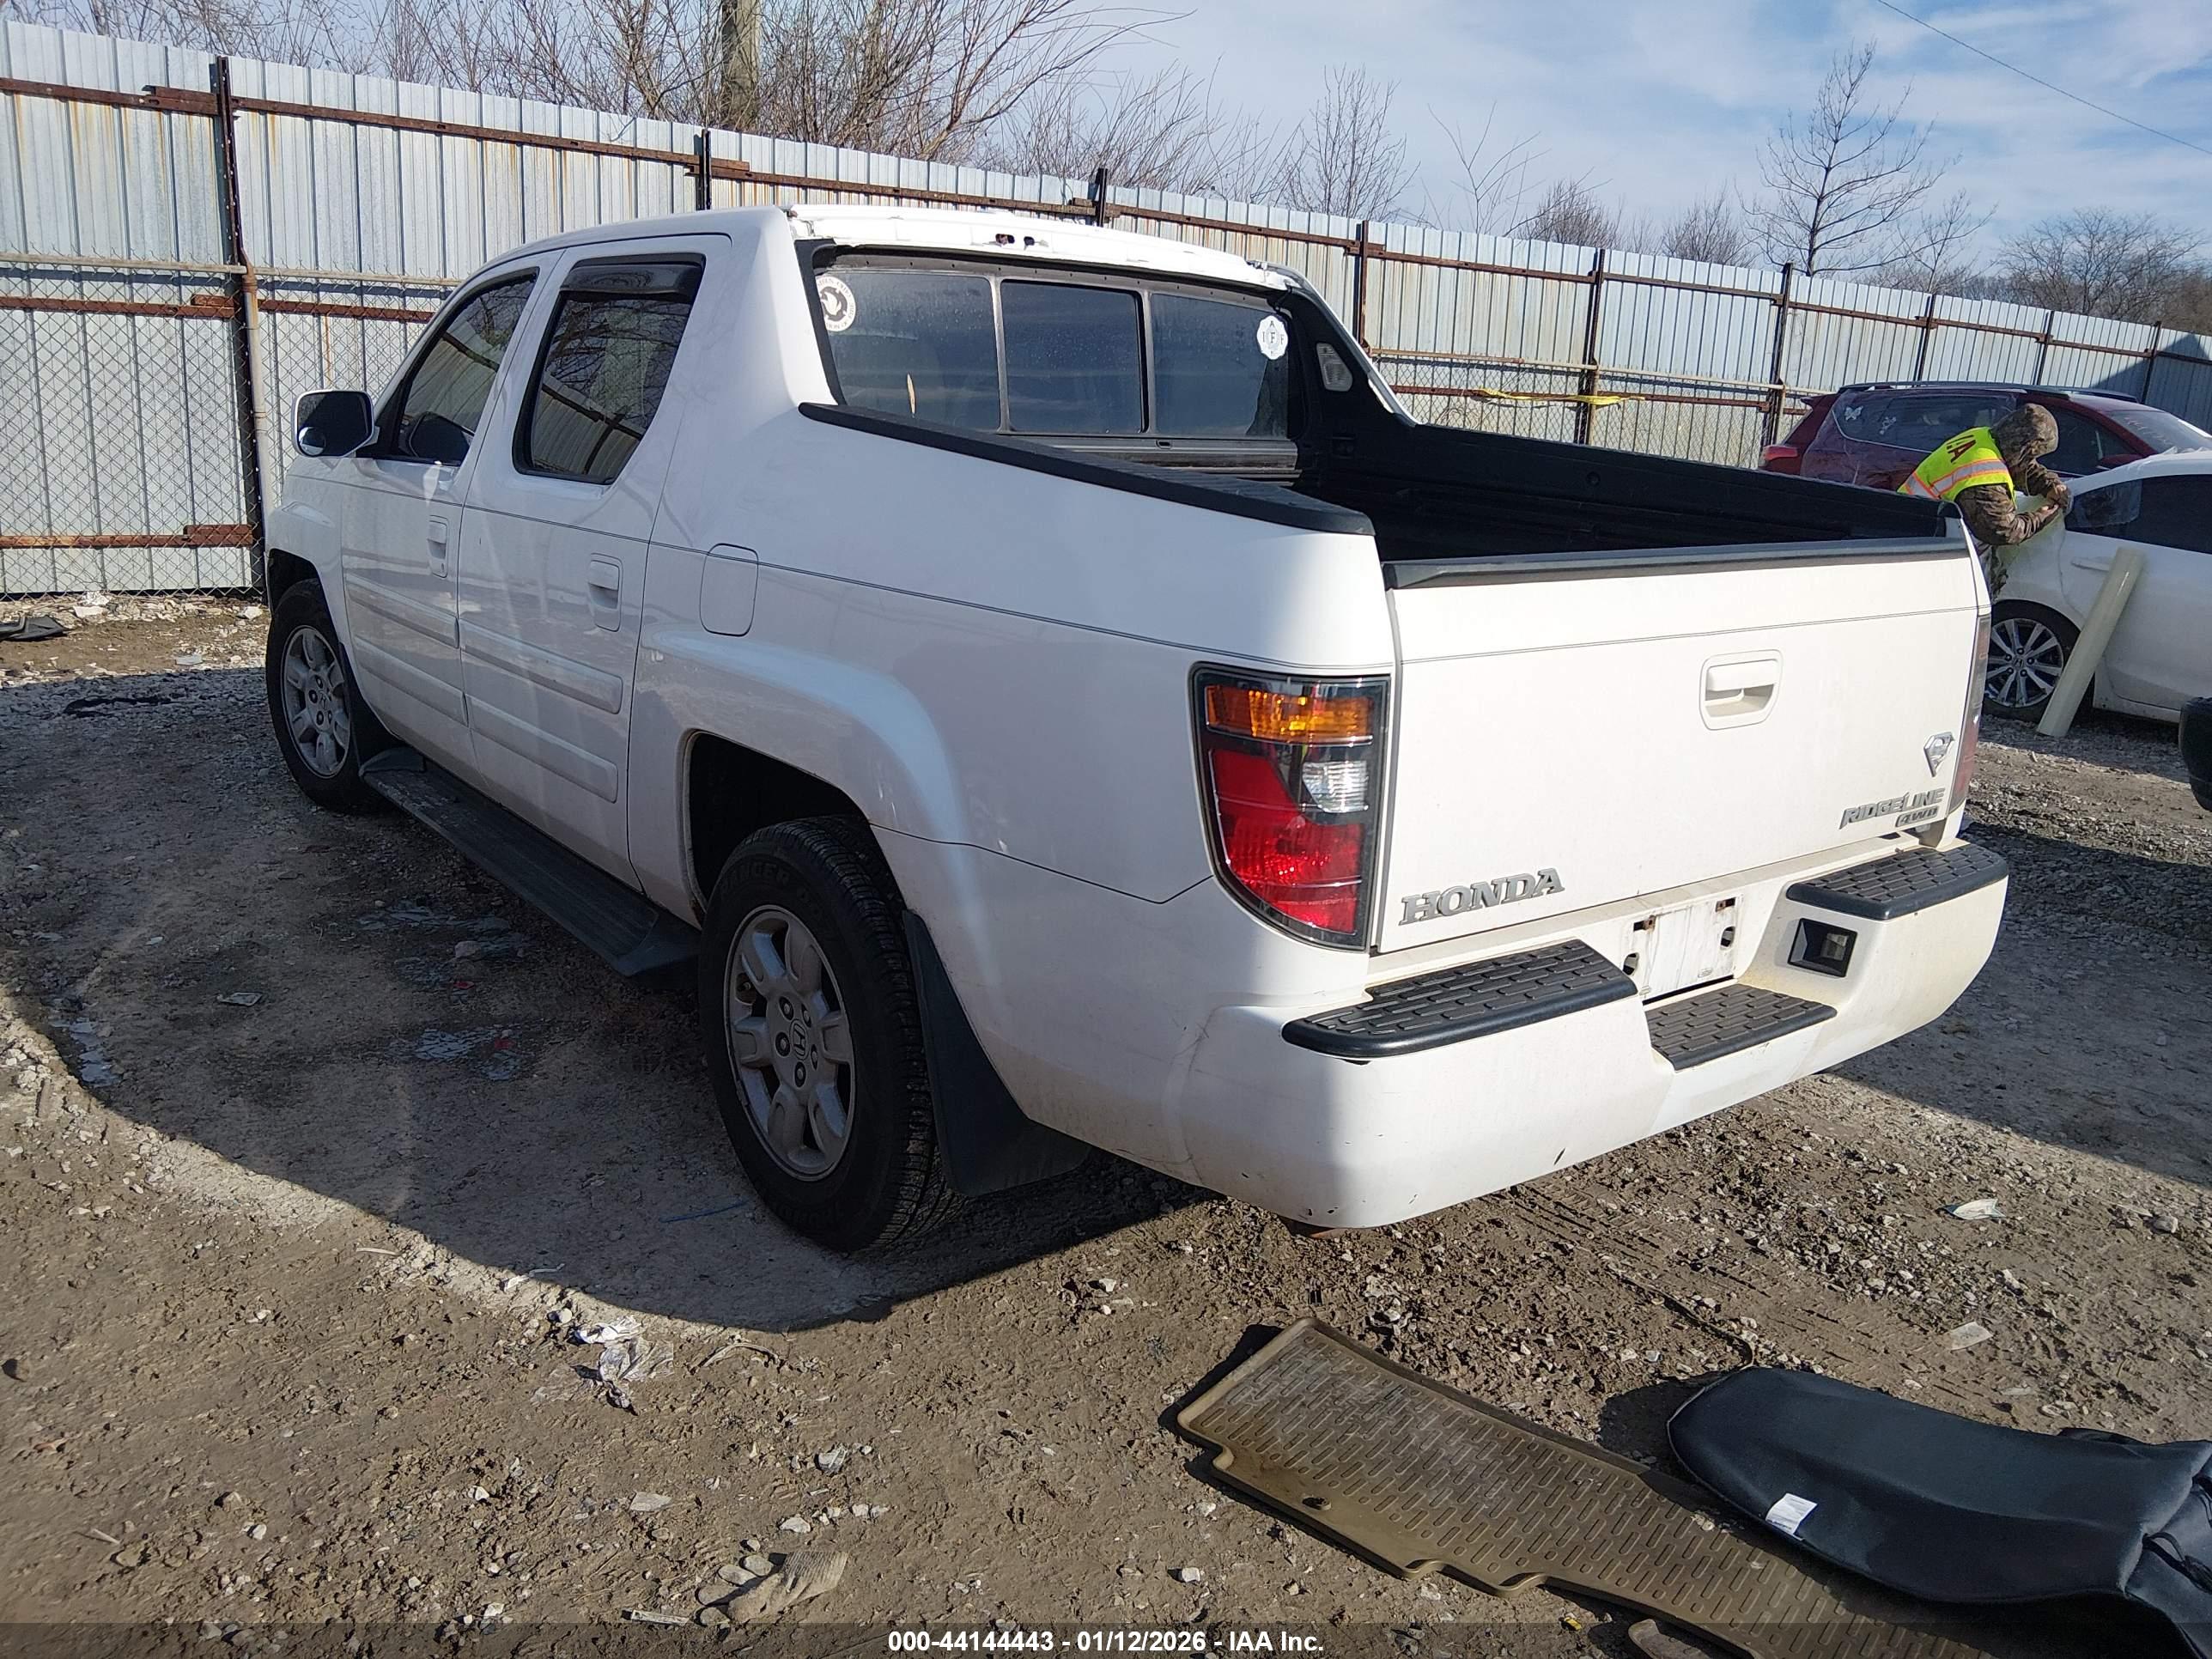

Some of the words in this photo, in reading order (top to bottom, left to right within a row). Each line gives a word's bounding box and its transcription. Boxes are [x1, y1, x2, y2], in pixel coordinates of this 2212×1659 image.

[1839, 787, 1945, 830] RIDGELINE
[1899, 806, 1939, 826] 4WD
[1398, 867, 1565, 926] HONDA
